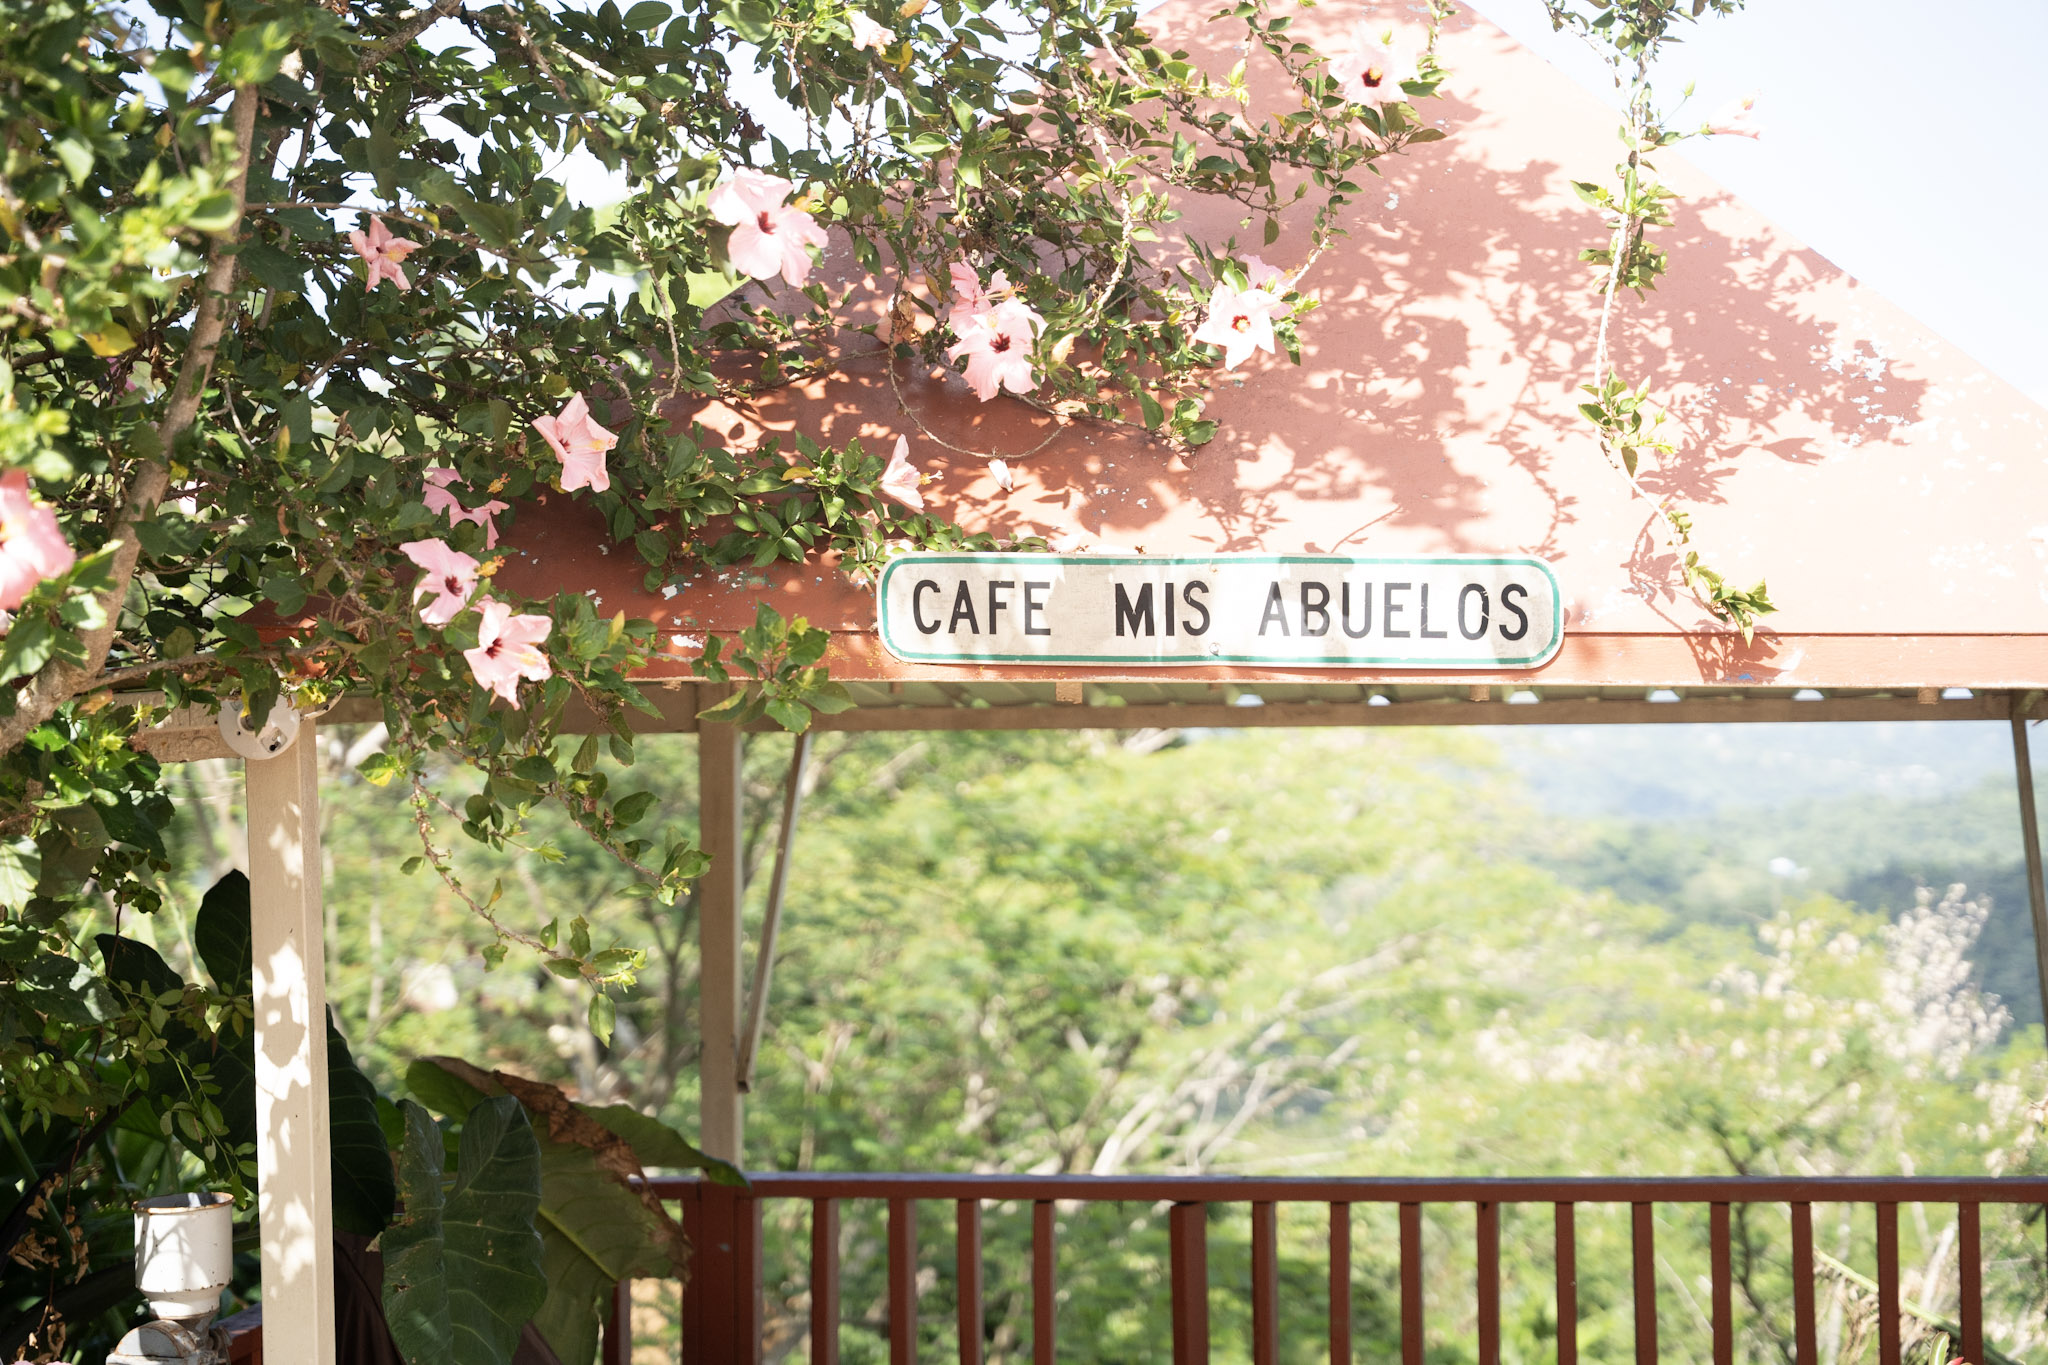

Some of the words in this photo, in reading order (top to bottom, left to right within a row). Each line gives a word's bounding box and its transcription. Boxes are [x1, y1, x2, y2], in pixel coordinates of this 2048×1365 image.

[912, 579, 1051, 636] CAFE
[1114, 580, 1211, 639] MIS
[1258, 581, 1529, 641] ABUELOS
